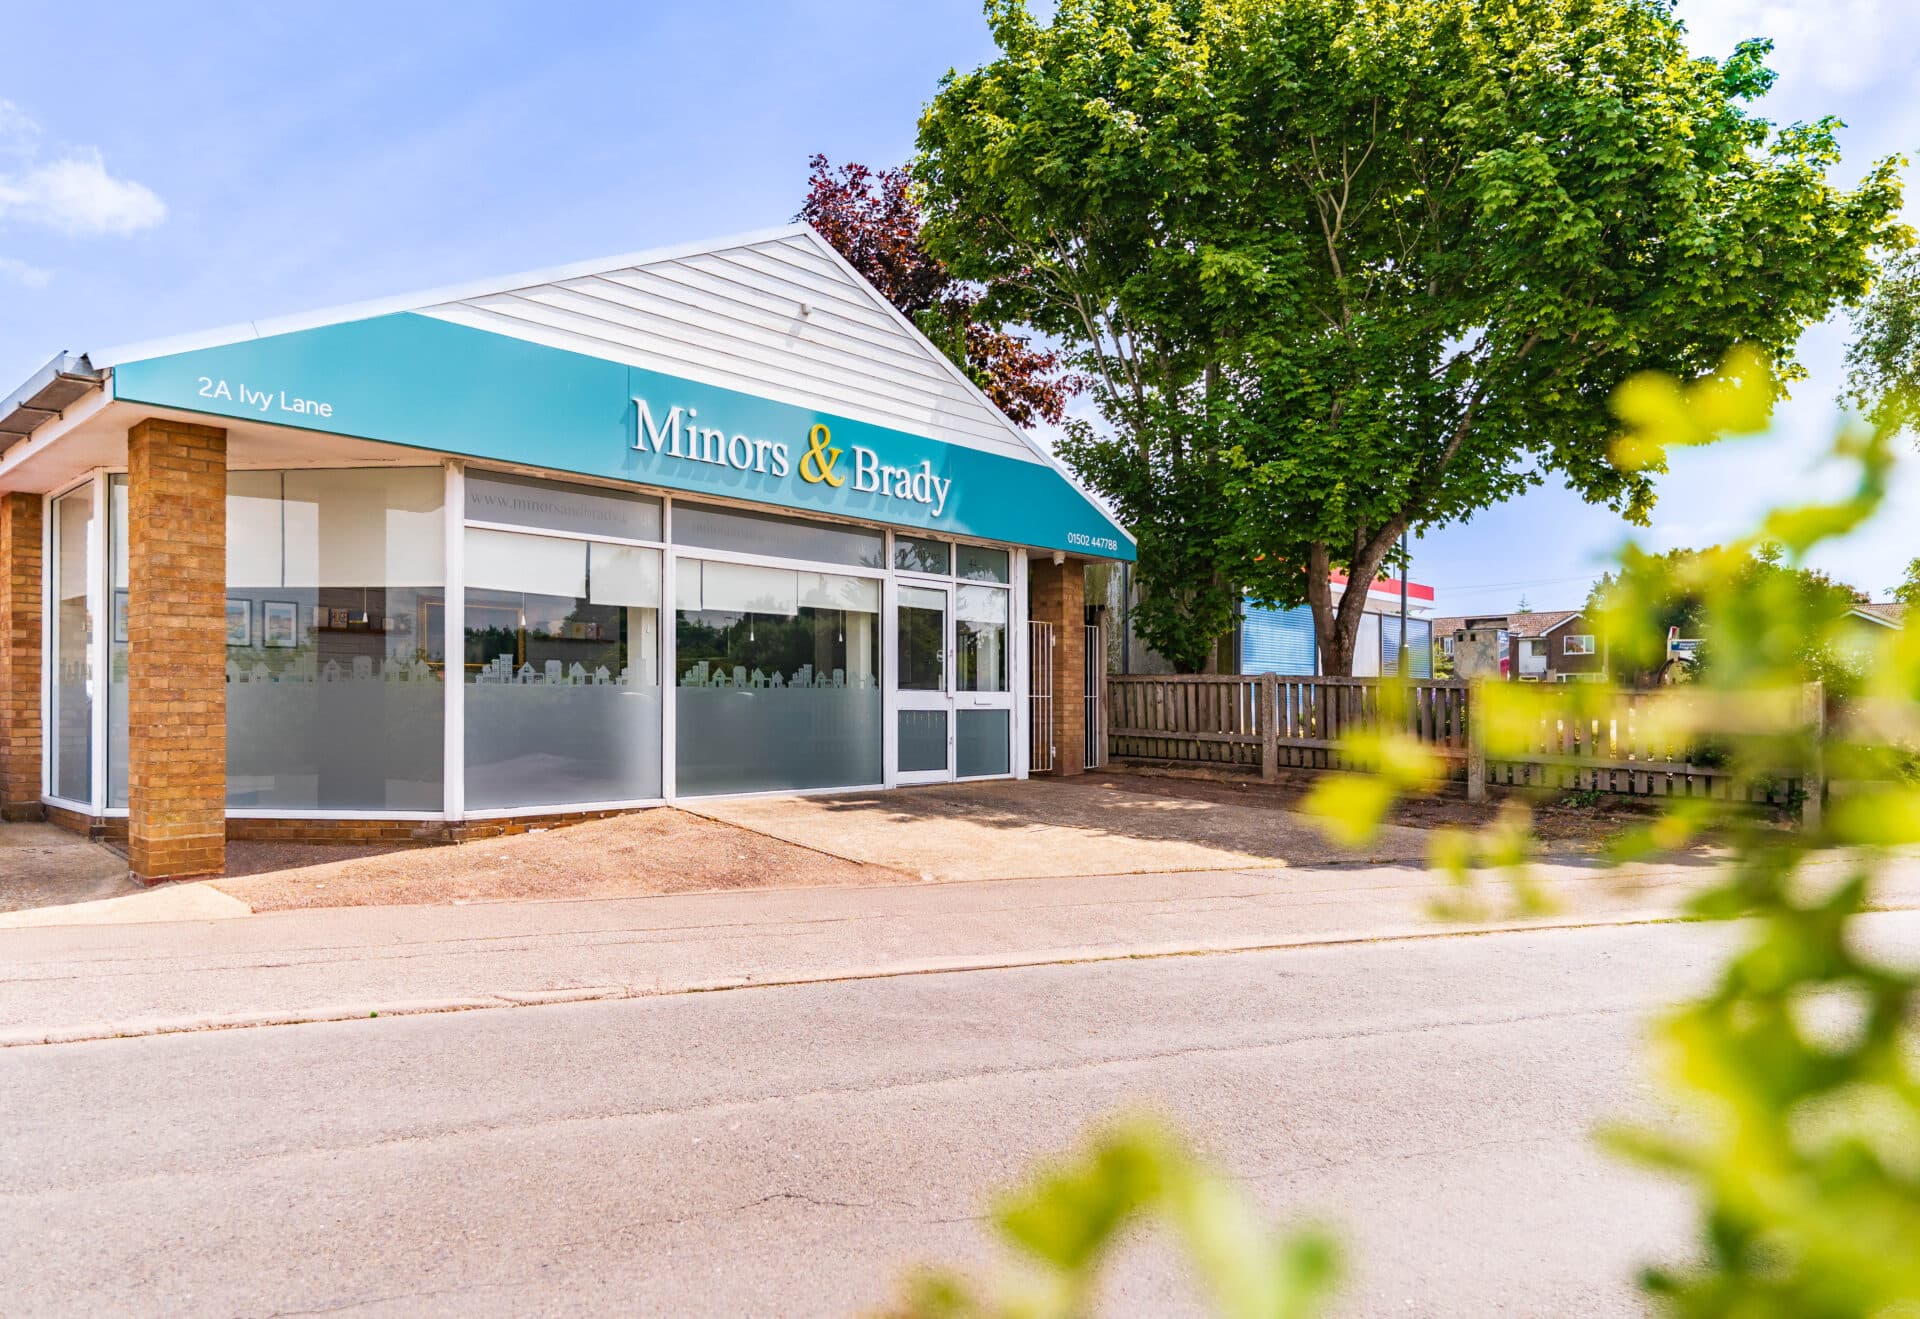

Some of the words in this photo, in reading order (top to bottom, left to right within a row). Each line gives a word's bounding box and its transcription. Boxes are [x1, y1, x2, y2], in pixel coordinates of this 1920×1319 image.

[198, 376, 232, 400] 2A
[239, 383, 274, 412] Ivy
[280, 391, 333, 417] Lane
[631, 398, 789, 477] Minors
[798, 423, 845, 487] &
[852, 446, 951, 517] Brady
[1067, 532, 1090, 546] 01502
[1091, 536, 1118, 551] 447788
